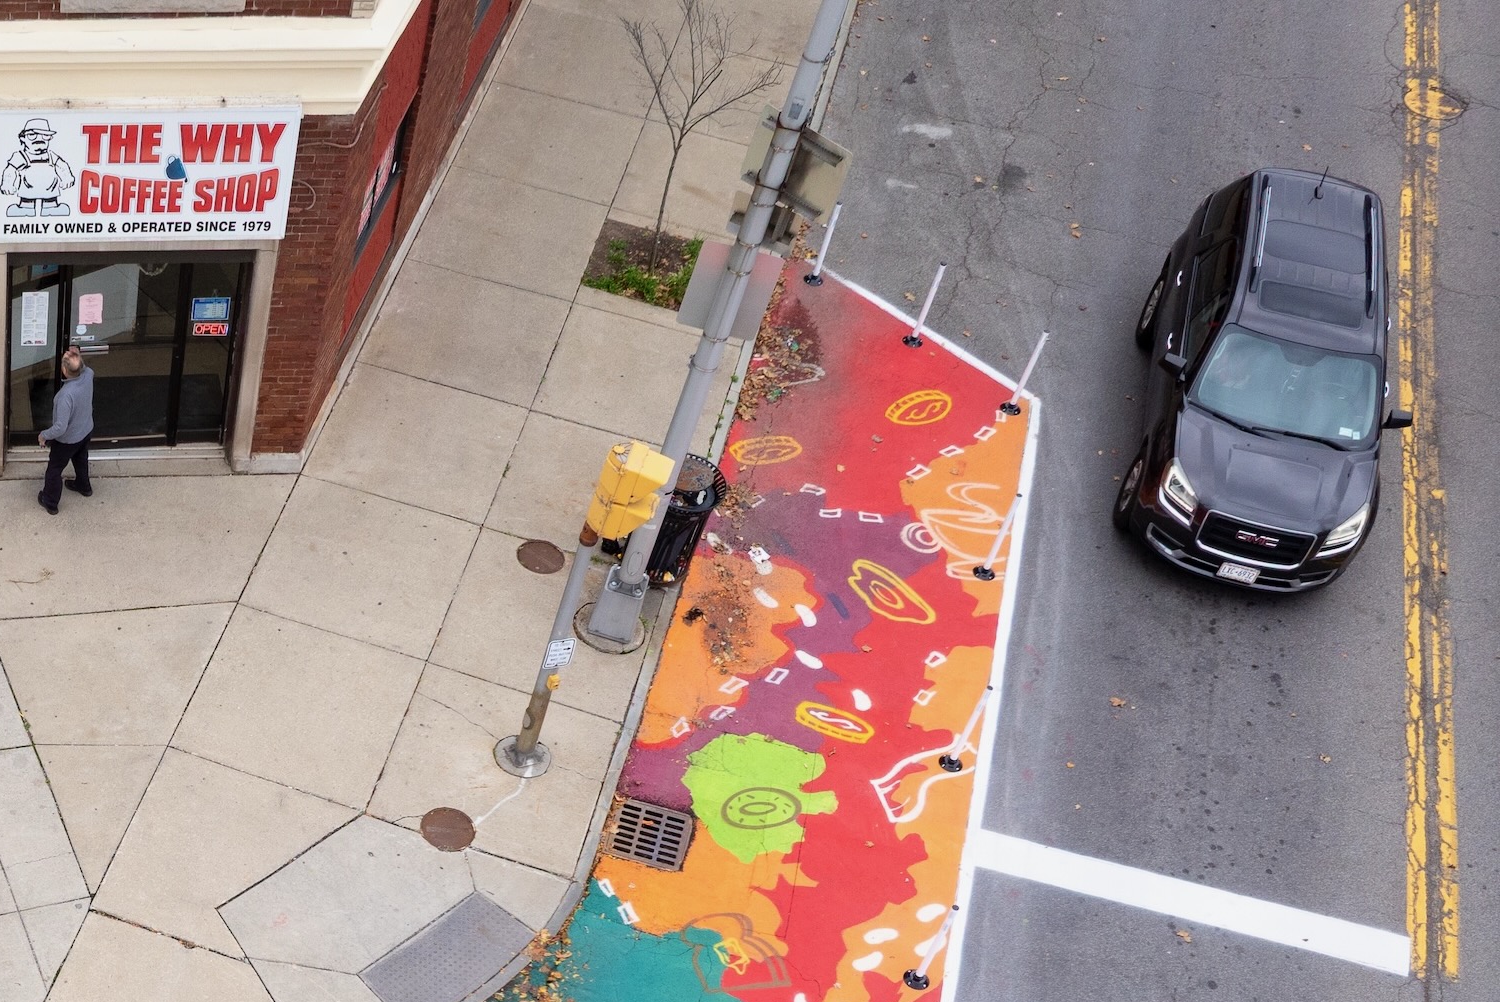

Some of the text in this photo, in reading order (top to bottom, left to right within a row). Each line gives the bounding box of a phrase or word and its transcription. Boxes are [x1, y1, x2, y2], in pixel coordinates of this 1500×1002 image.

[81, 123, 288, 164] THE WHY
[79, 168, 280, 213] COFFEE SHOP
[3, 220, 271, 235] FAMILY OWNED & OPERATED SINCE 1979
[195, 324, 227, 335] OPEN
[1236, 530, 1279, 548] GMC
